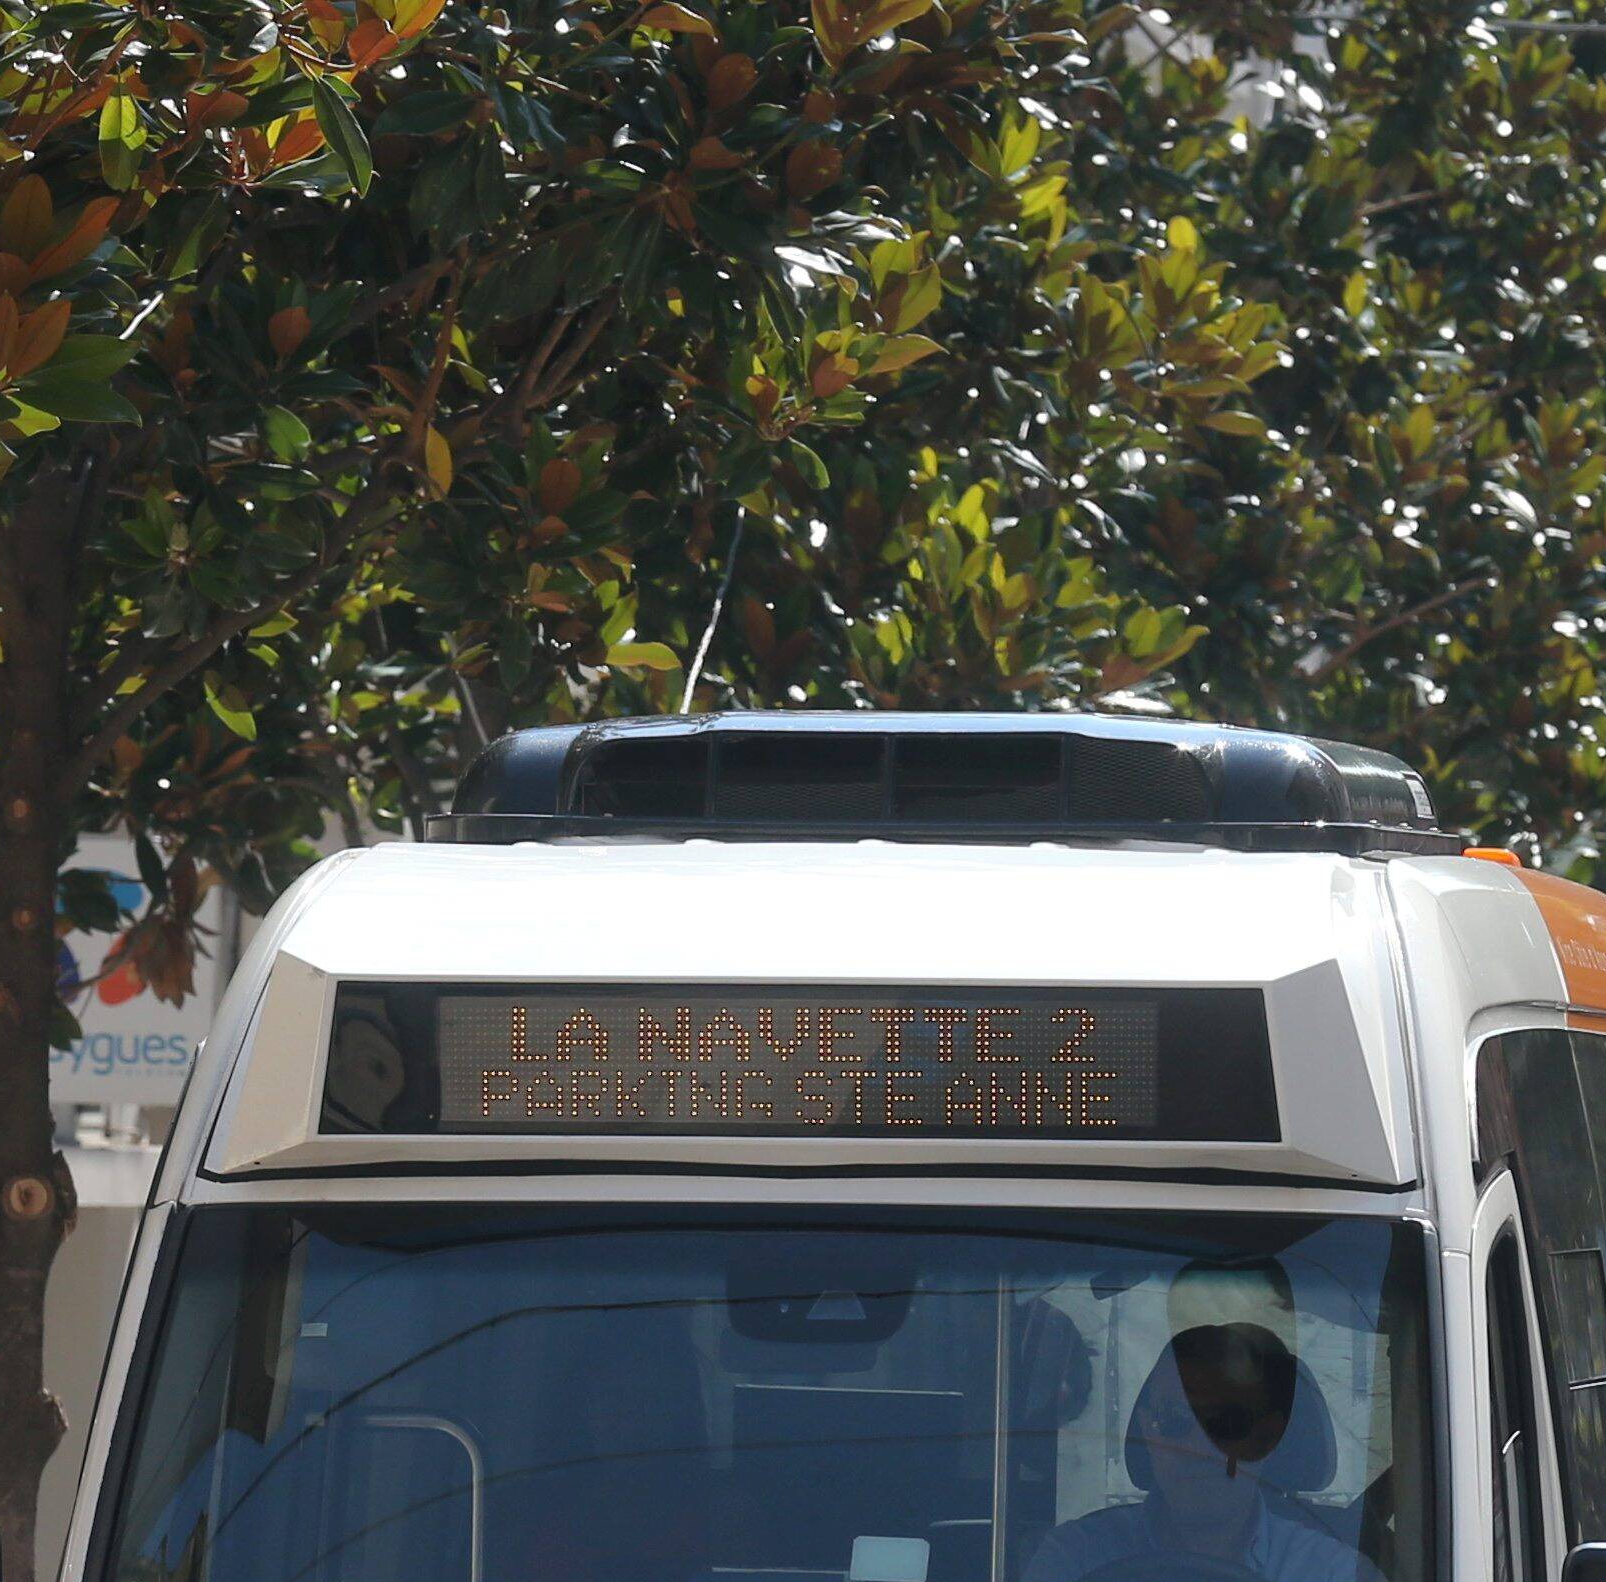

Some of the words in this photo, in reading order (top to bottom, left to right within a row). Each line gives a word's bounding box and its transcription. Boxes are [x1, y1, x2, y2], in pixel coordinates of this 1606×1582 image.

[49, 1031, 188, 1077] ygues
[510, 1007, 609, 1063] LA
[638, 1007, 1022, 1063] NAVETTE
[1050, 1008, 1096, 1064] 2
[481, 1069, 775, 1118] PARKING
[795, 1070, 924, 1126] STE
[944, 1070, 1119, 1127] ANNE
